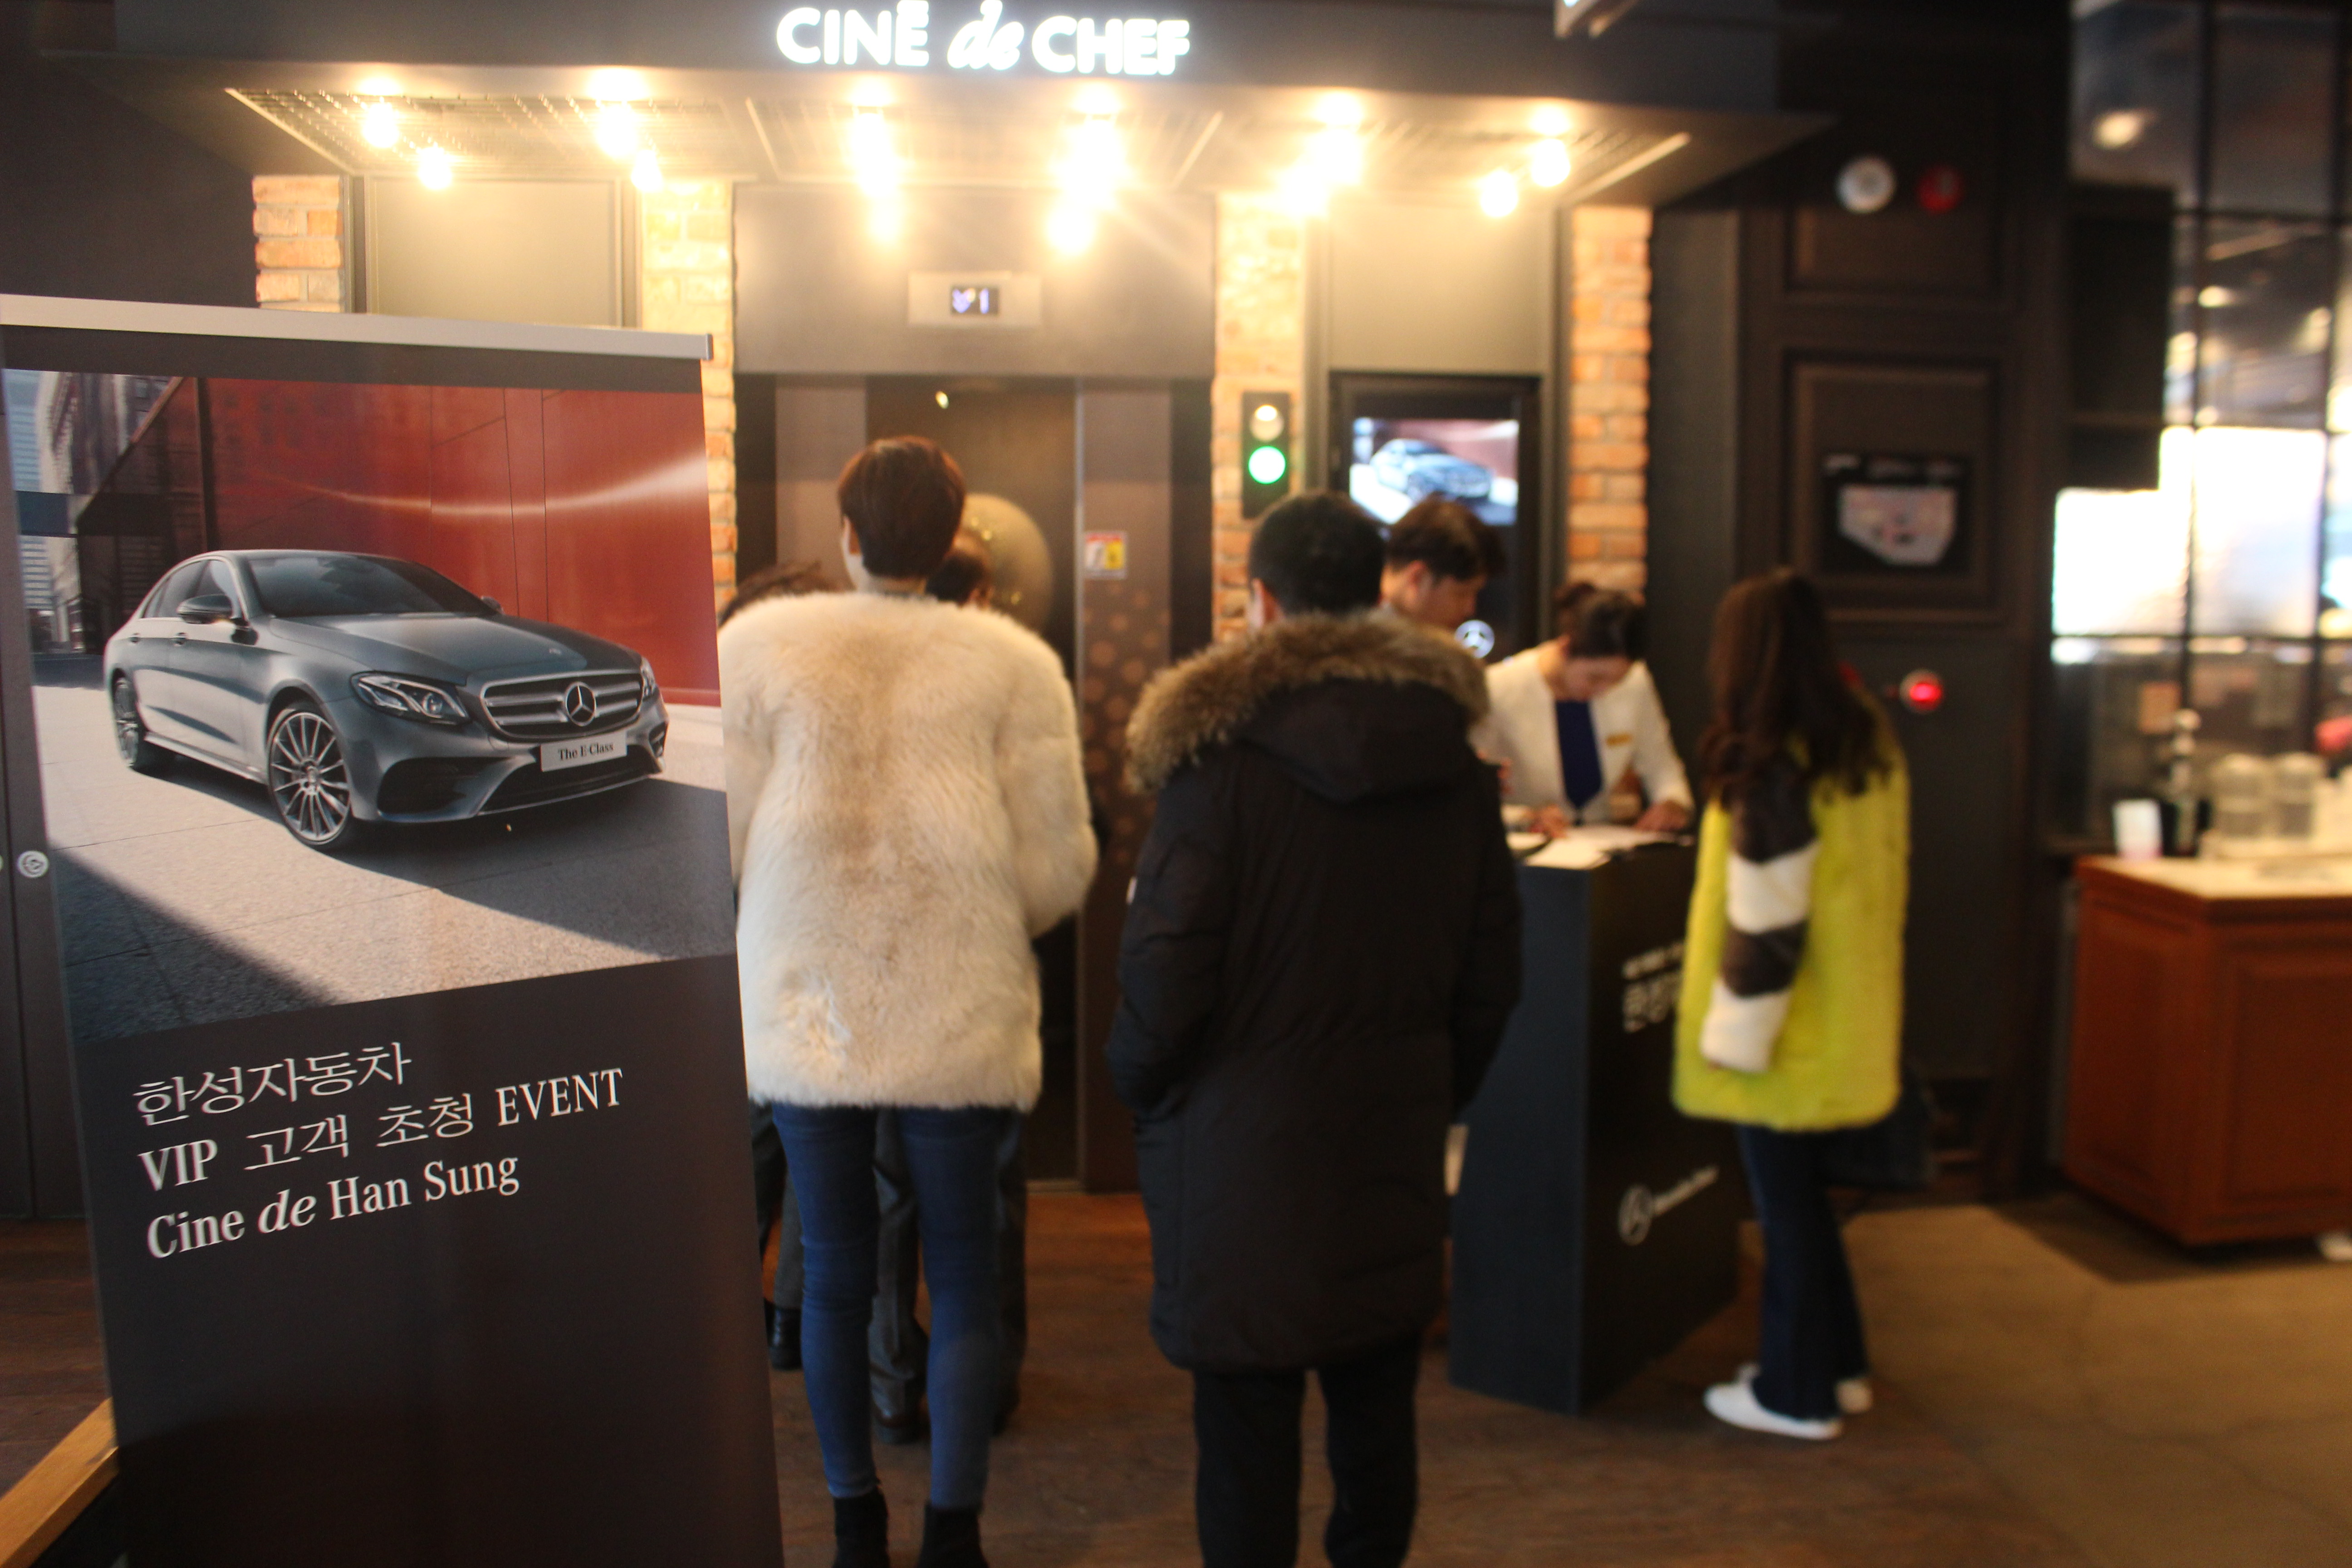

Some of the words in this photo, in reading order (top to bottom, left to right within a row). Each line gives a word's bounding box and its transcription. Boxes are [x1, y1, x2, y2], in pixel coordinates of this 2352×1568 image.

[947, 0, 1024, 71] de
[1032, 16, 1190, 75] CHEF
[559, 748, 578, 761] The
[133, 1042, 412, 1125] 한성자동차
[138, 1139, 217, 1191] VIP
[245, 1114, 348, 1170] 고객
[377, 1093, 473, 1147] 초청
[495, 1068, 622, 1126] EVENT
[148, 1211, 245, 1258] Cine
[258, 1189, 316, 1233] de
[327, 1176, 412, 1220] Han
[424, 1157, 519, 1201] Sung
